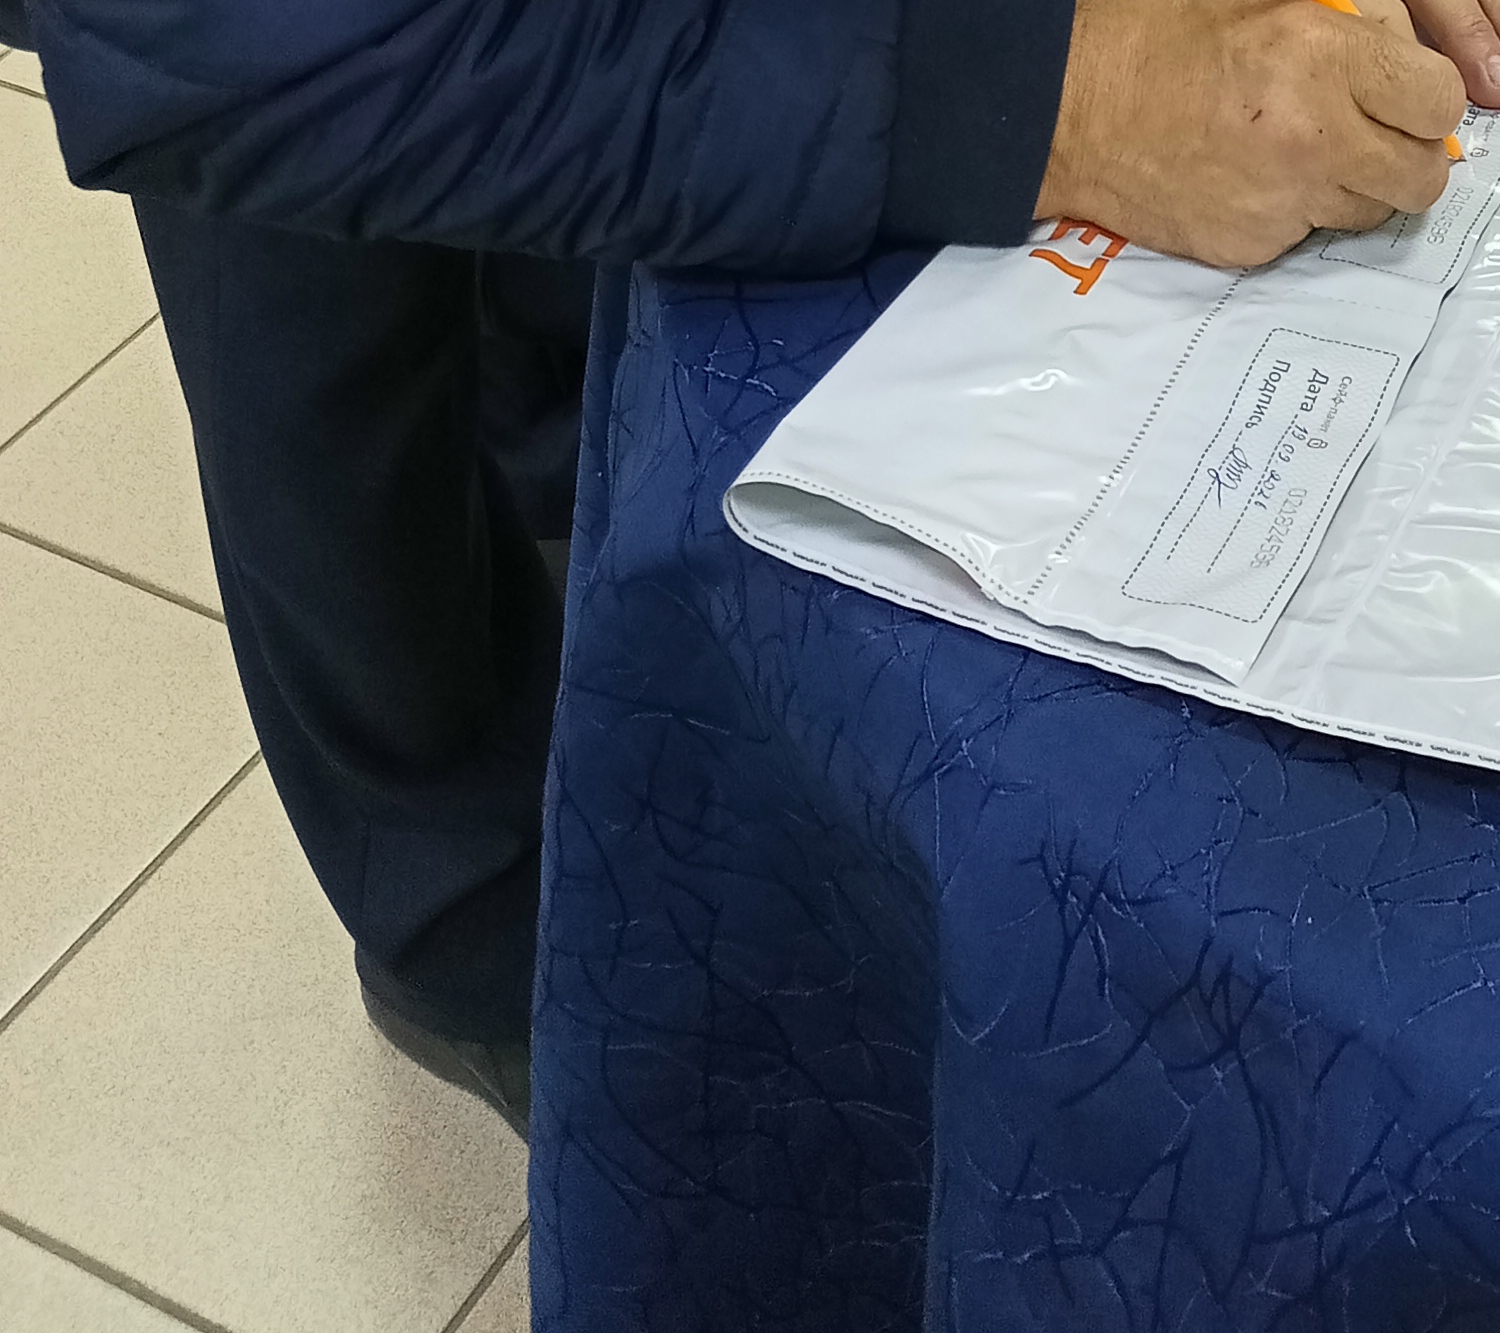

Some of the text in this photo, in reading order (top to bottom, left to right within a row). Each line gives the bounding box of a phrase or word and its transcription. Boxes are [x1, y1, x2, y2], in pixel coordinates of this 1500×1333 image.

[1462, 104, 1481, 126] ата
[1245, 359, 1292, 429] Подпись
[1300, 368, 1329, 413] Дата
